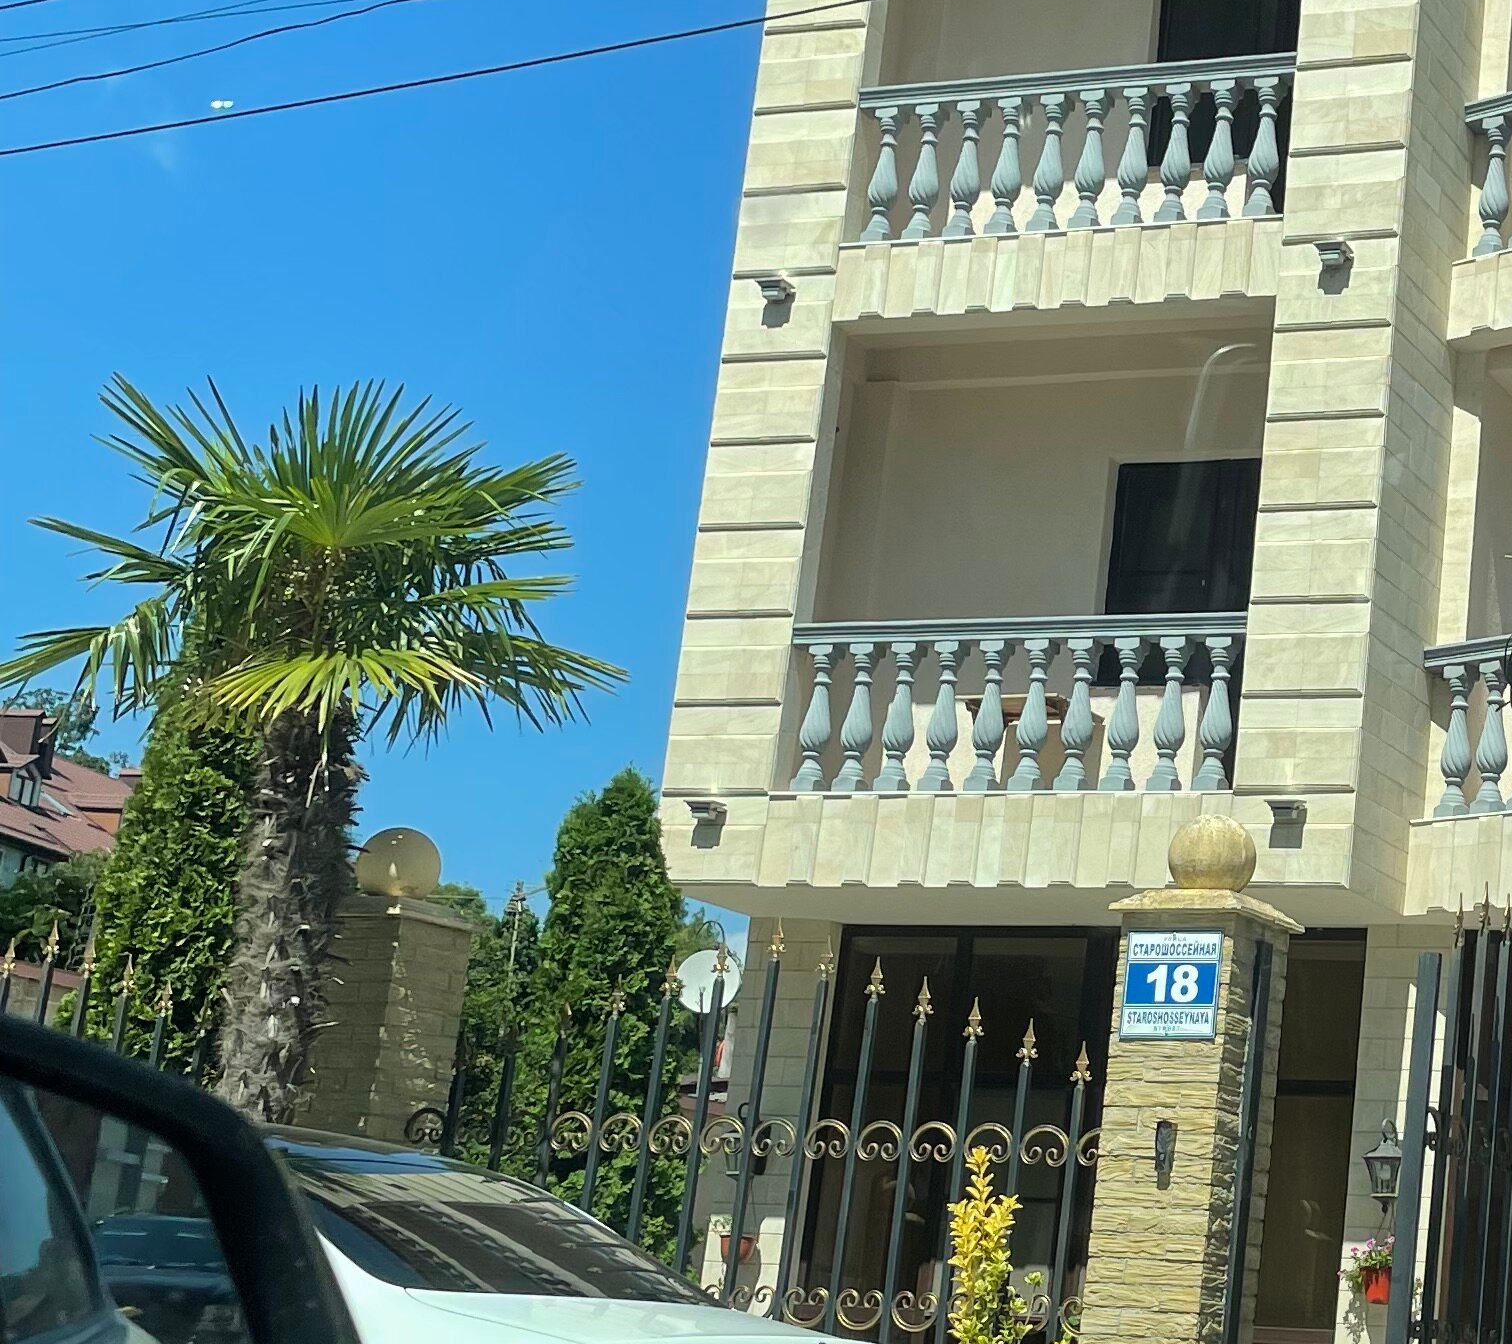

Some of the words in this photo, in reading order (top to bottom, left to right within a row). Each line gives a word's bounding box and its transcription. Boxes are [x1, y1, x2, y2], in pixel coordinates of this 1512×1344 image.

[1133, 940, 1217, 957] СТАРОШОССЕЙНАЯ
[1146, 964, 1199, 1003] 18
[1127, 1011, 1210, 1025] STAROSHOSSEYNAYA
